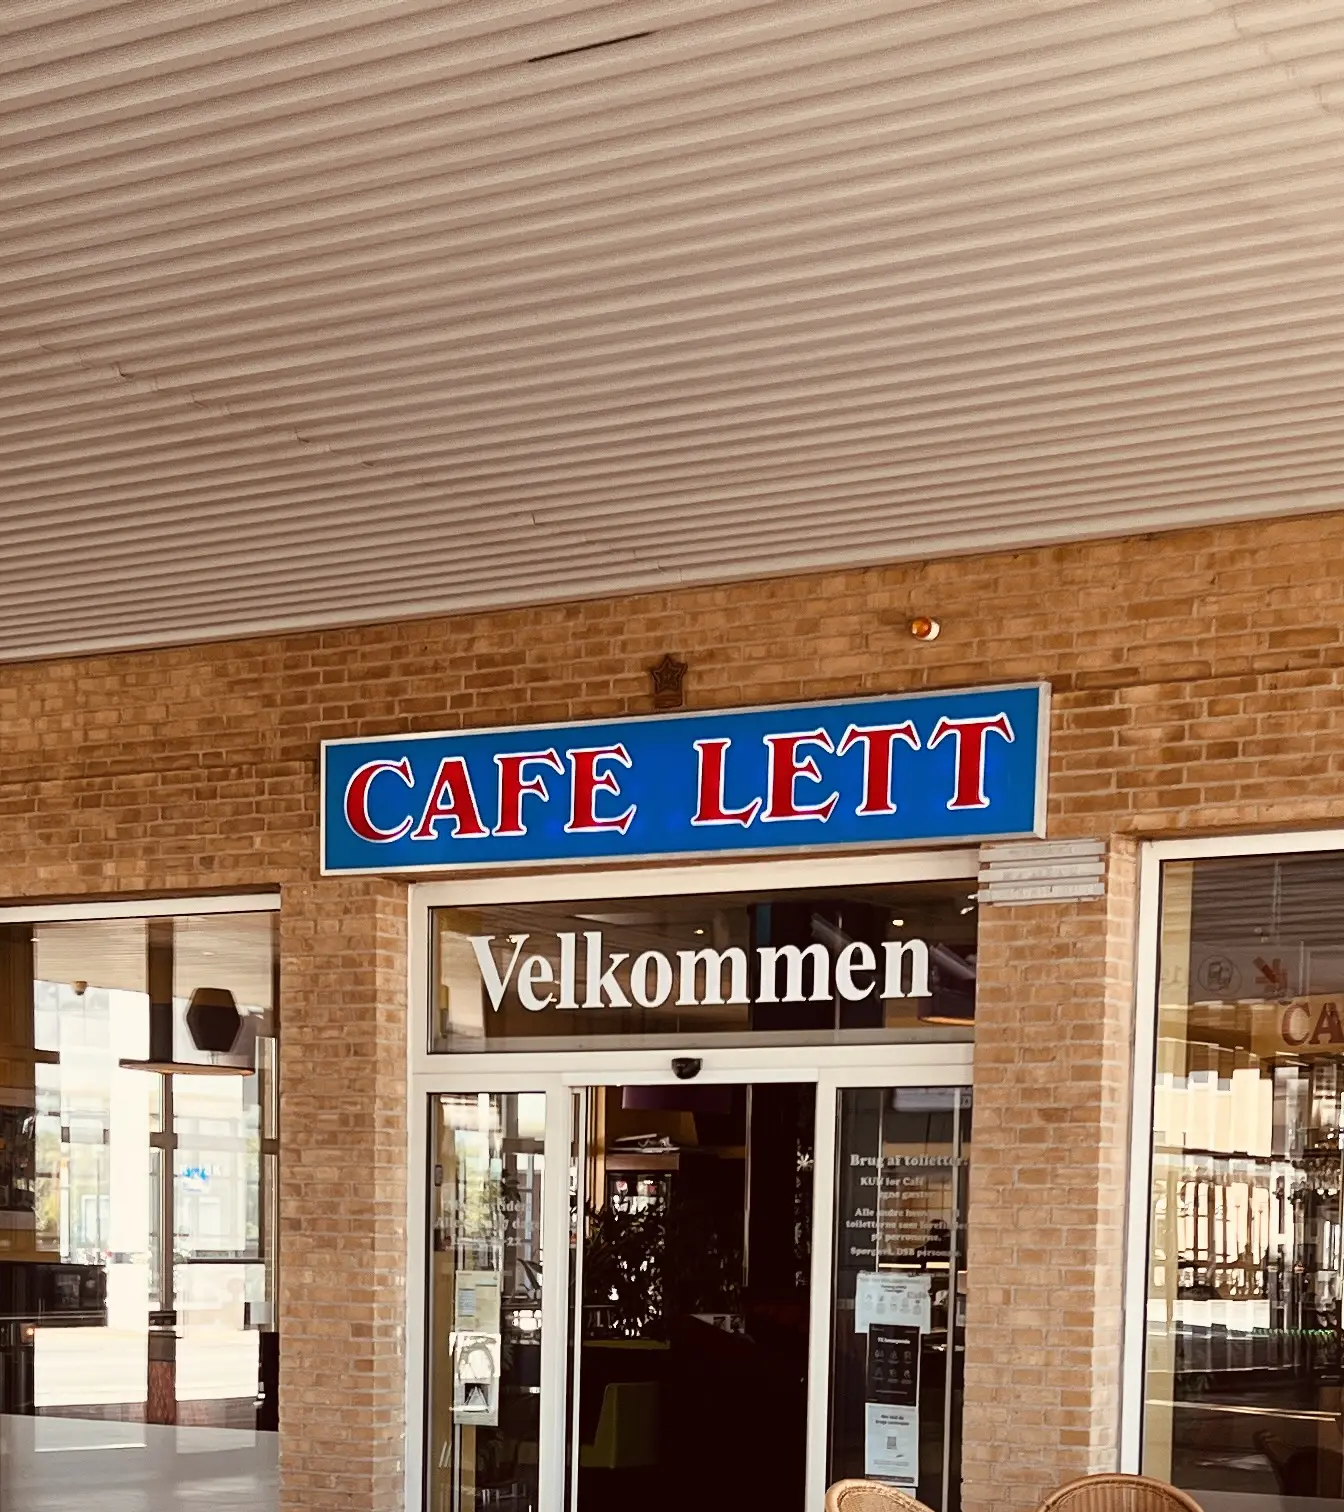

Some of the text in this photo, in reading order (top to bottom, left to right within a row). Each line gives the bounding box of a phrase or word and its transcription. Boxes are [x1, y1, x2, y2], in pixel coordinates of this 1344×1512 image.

[344, 712, 1015, 843] CAFE LETT
[467, 931, 933, 1012] Velkommen
[850, 1154, 884, 1168] Brug
[887, 1156, 901, 1166] af
[855, 1208, 875, 1217] Alle
[896, 1248, 915, 1256] DSB
